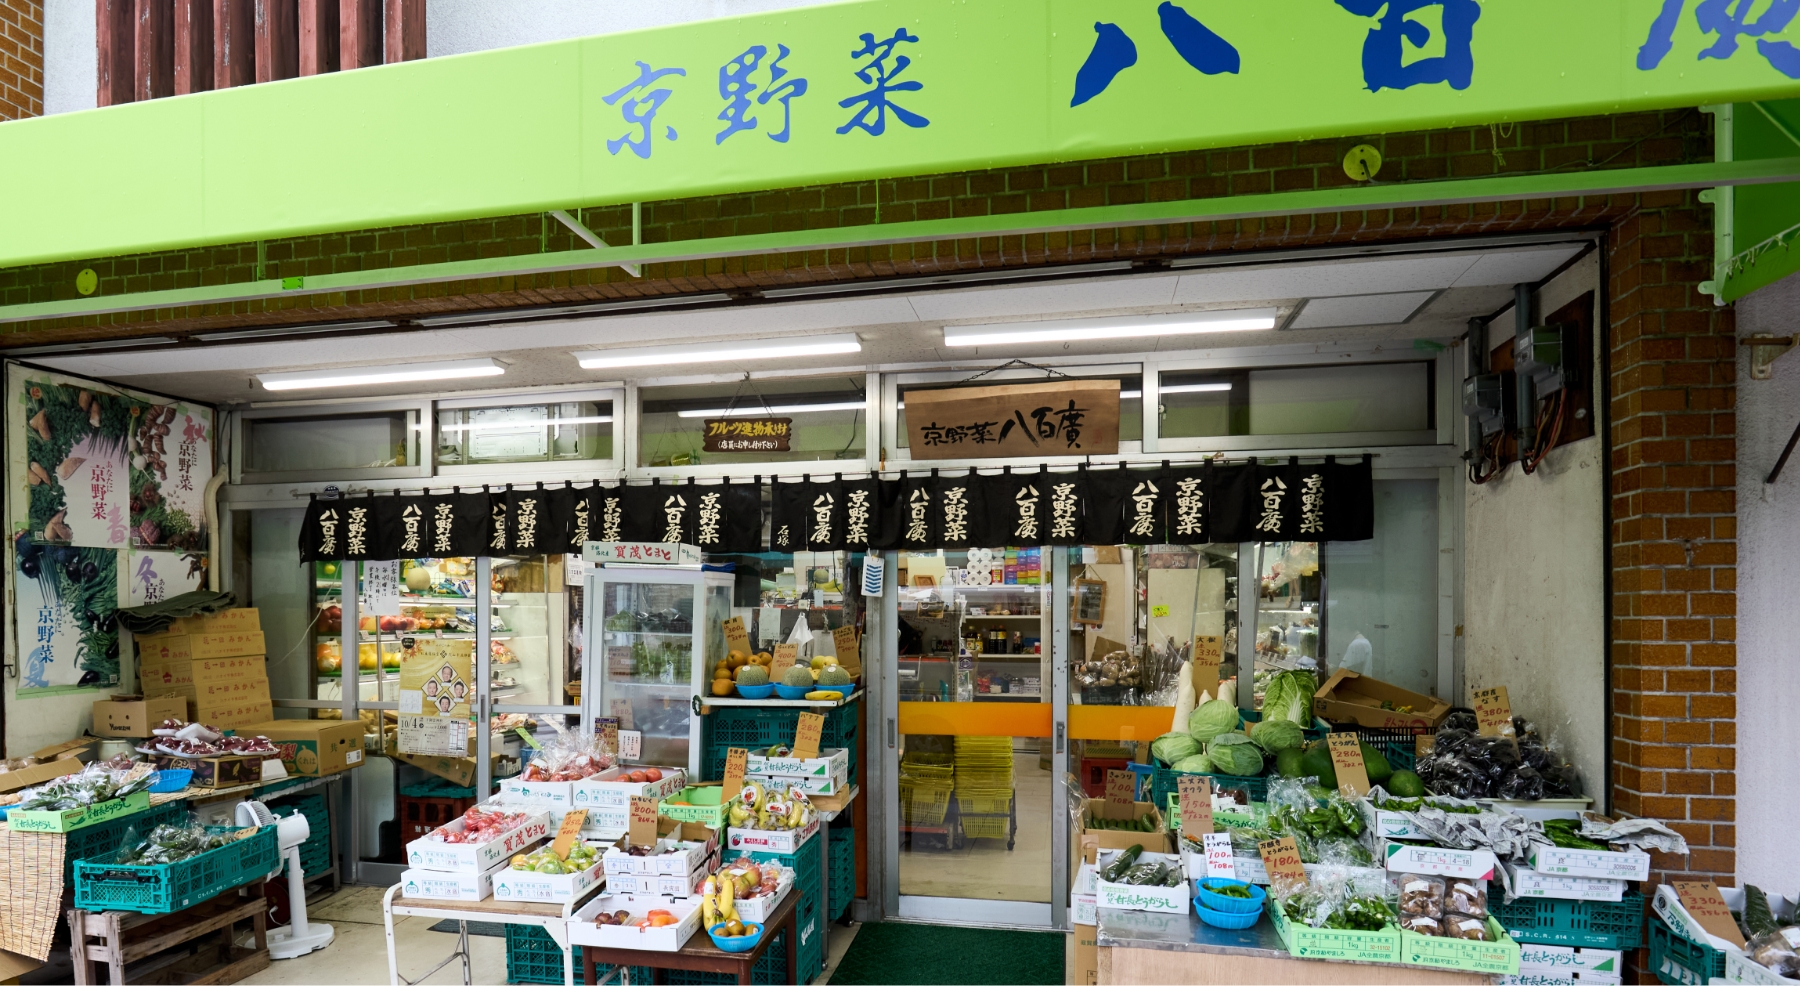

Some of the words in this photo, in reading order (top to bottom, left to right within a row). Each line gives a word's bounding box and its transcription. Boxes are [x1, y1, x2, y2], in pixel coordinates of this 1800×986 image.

[601, 27, 930, 159] 京野菜
[183, 416, 207, 443] 秋
[921, 421, 998, 445] 京野菜
[998, 400, 1090, 449] 八百廣
[178, 440, 194, 492] 京野菜
[90, 464, 107, 521] 京野菜
[906, 487, 930, 542] 八百廣
[943, 486, 968, 541] 京野菜
[1015, 484, 1039, 539] 八百廣
[1052, 483, 1077, 538] 京野菜
[1130, 479, 1159, 536] 八百廣
[1176, 478, 1203, 534] 京野菜
[1256, 476, 1287, 533] 八百廣
[1300, 474, 1324, 533] 京野菜
[106, 503, 129, 544] 春
[319, 508, 339, 555] 八百廣
[348, 507, 367, 554] 京野菜
[401, 504, 422, 552] 八百廣
[435, 503, 453, 551] 京野菜
[517, 498, 537, 548] 京野菜
[662, 494, 687, 543] 八百廣
[699, 492, 720, 544] 京野菜
[810, 492, 835, 544] 八百廣
[846, 490, 869, 544] 京野菜
[614, 545, 671, 561] 賀茂とまと
[37, 604, 55, 664] 京野菜
[1482, 707, 1510, 717] 380円
[1185, 800, 1211, 808] 150円
[503, 824, 545, 854] 賀茂とまと
[1260, 839, 1281, 850] 万願寺
[1273, 856, 1300, 868] 180円
[1115, 894, 1179, 909] 甘長とうがらし
[1677, 882, 1710, 891] ゴーヤ
[1688, 897, 1725, 906] 330円
[1348, 941, 1359, 949] 1kg
[1462, 951, 1474, 959] 1kg
[1521, 950, 1586, 967] 甘長とうがらし
